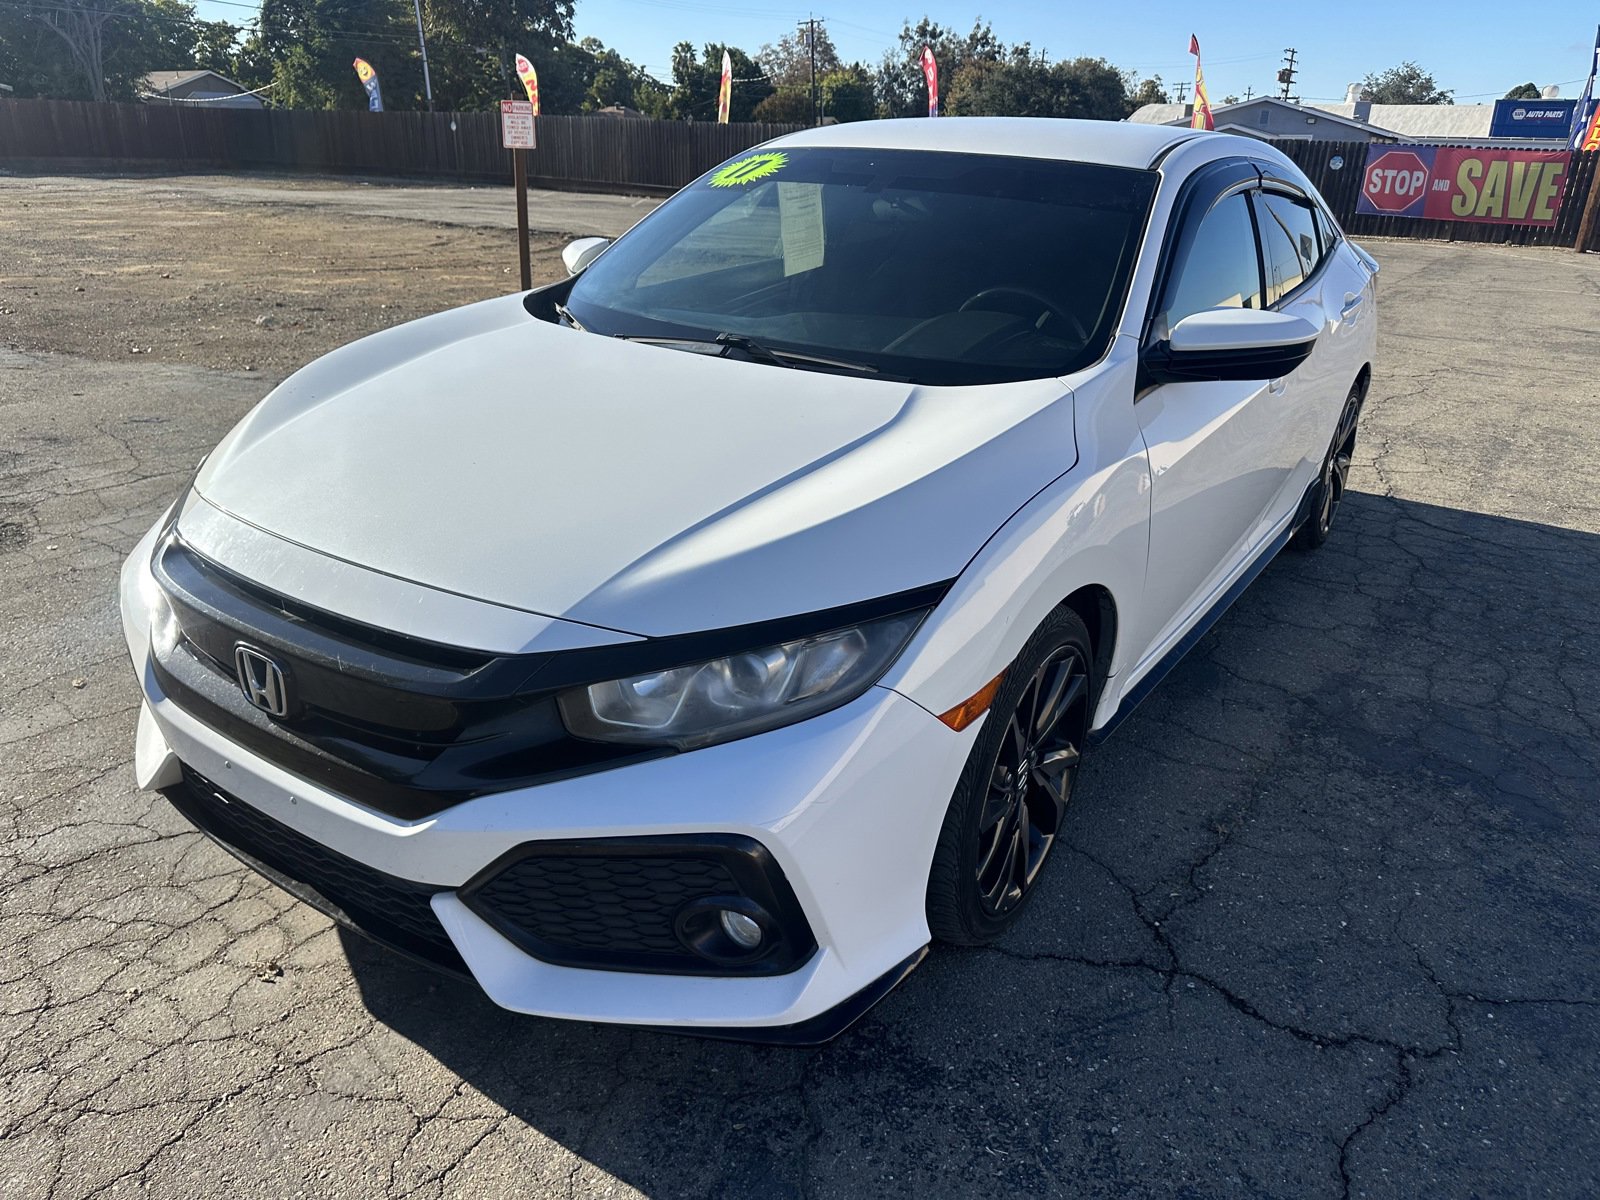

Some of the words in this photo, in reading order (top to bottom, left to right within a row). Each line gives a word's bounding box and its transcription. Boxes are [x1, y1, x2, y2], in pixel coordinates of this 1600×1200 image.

[503, 102, 512, 112] NO
[512, 103, 531, 111] PARKING
[1526, 110, 1544, 118] AUTO
[1543, 110, 1565, 118] PARTS
[1368, 168, 1425, 196] STOP
[1432, 178, 1450, 192] AND
[1451, 158, 1565, 221] SAVE
